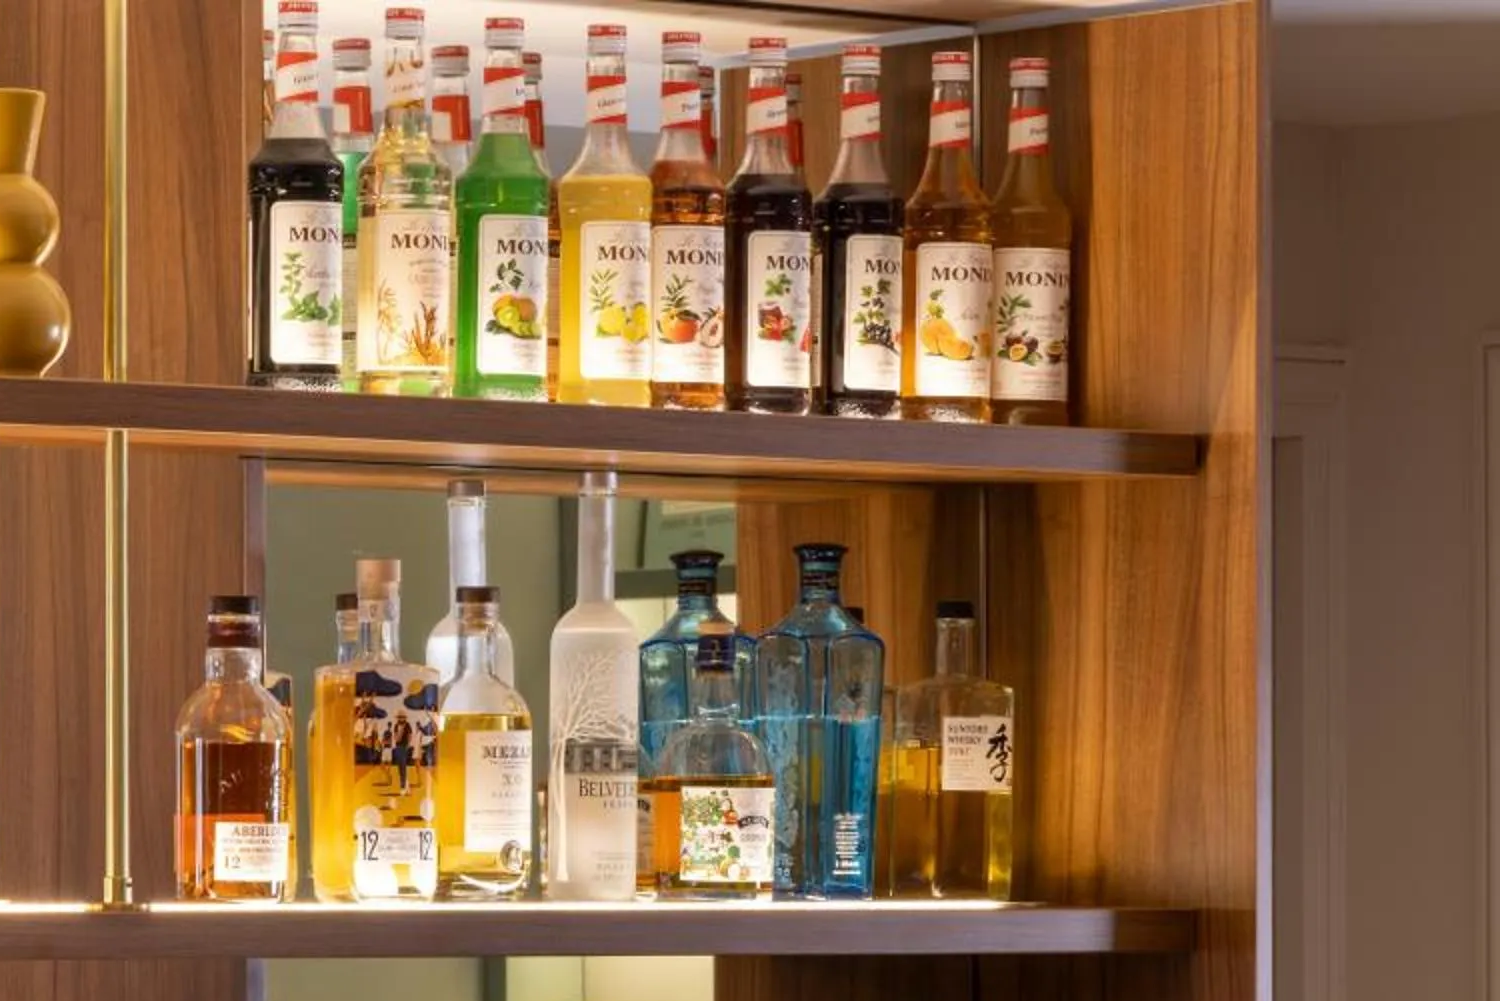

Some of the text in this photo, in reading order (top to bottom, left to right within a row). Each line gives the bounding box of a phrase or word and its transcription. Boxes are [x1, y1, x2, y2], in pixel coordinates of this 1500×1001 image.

[361, 830, 379, 861] 12
[419, 830, 433, 861] 12
[224, 855, 241, 870] 12
